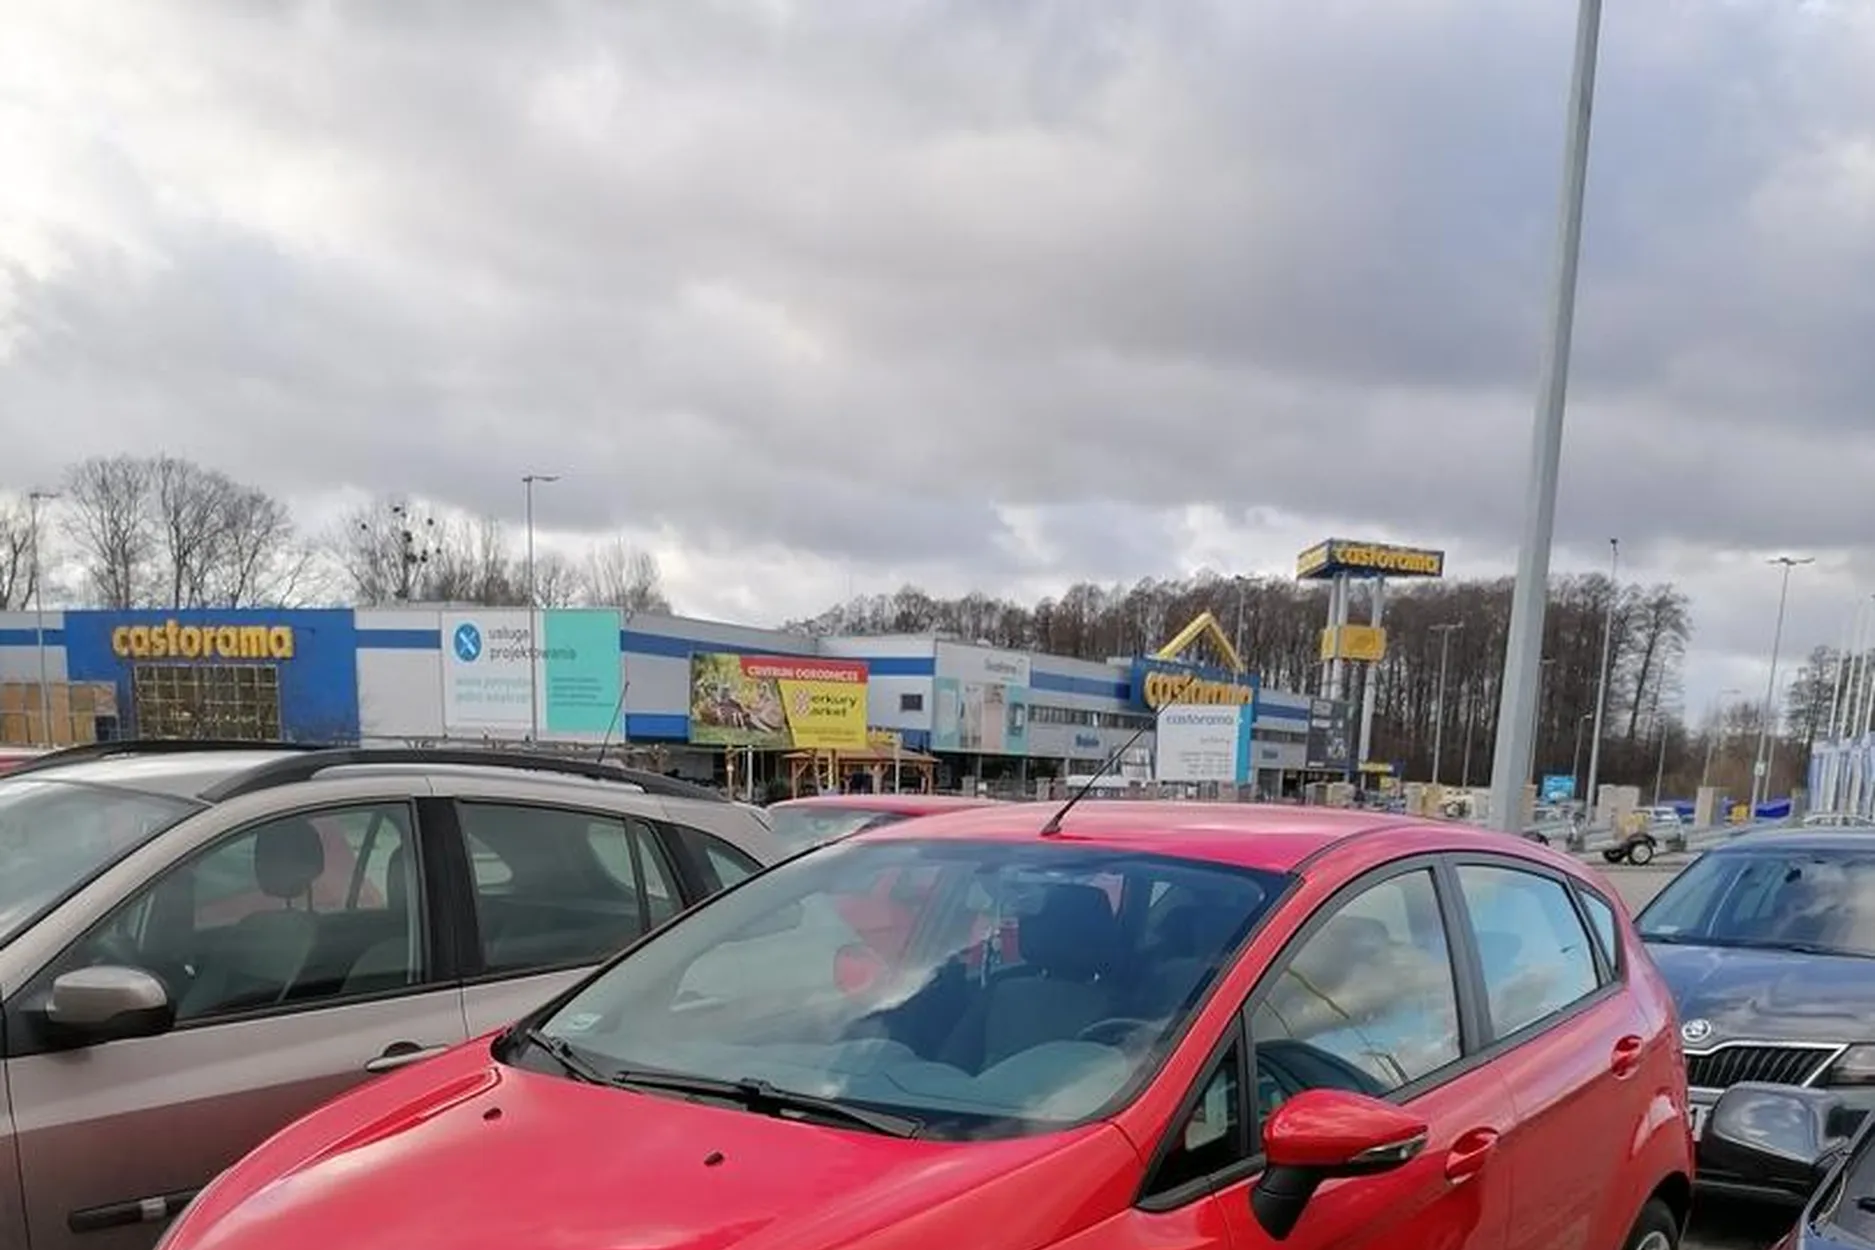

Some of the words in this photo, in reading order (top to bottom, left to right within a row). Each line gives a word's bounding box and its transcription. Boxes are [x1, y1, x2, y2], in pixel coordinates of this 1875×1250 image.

[1335, 546, 1440, 573] castorama
[113, 619, 293, 658] castorama
[1144, 671, 1253, 709] castorama
